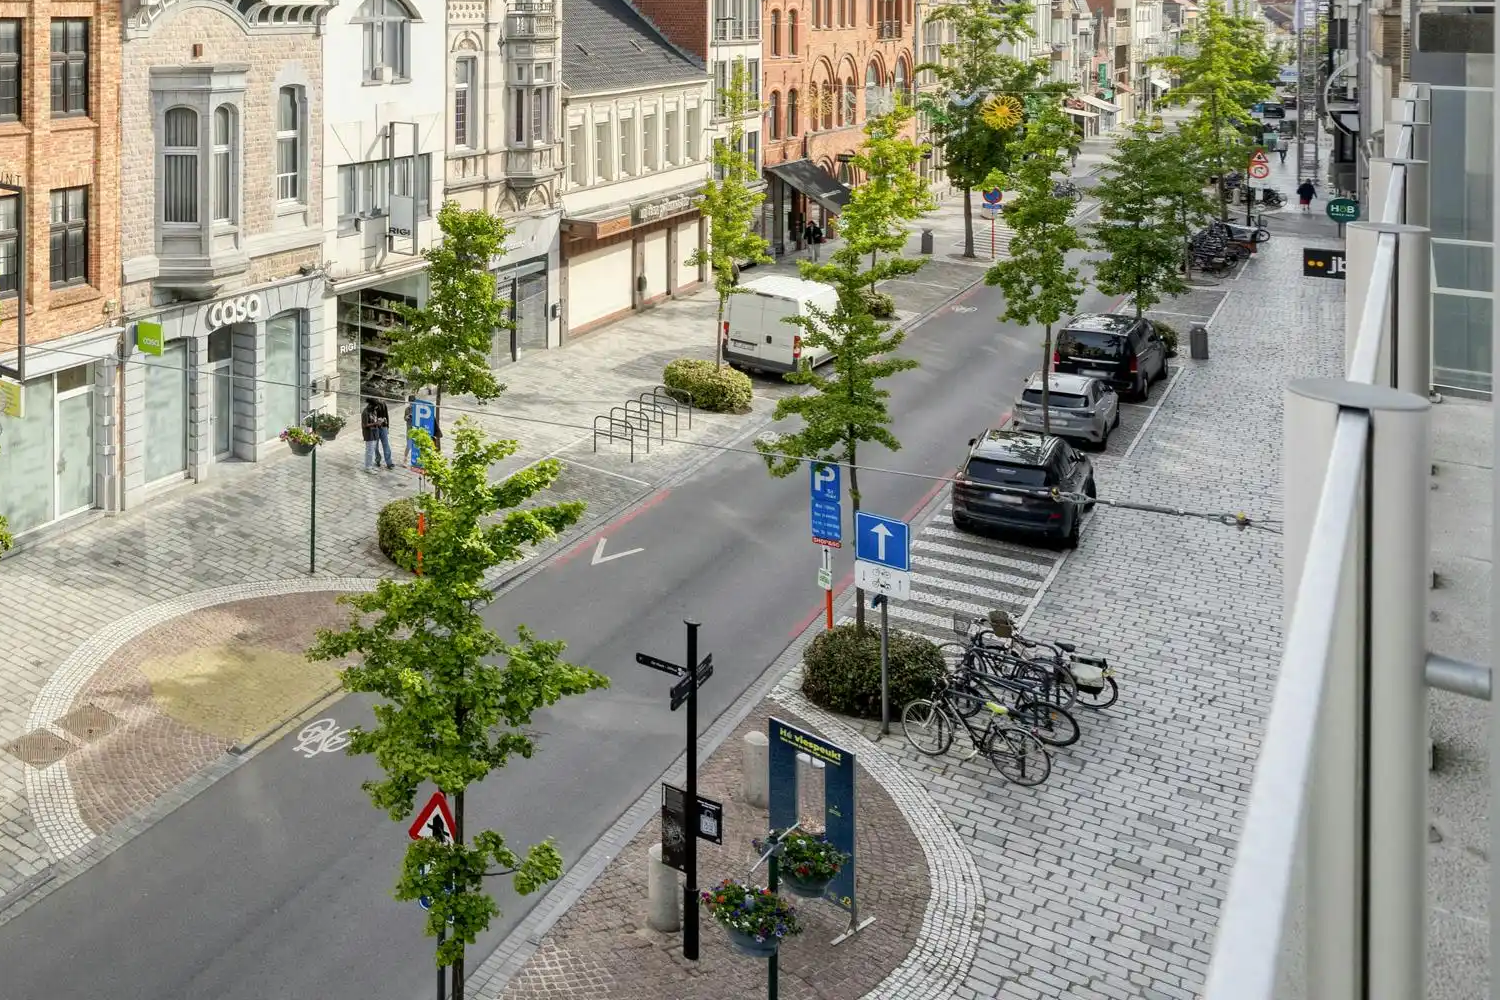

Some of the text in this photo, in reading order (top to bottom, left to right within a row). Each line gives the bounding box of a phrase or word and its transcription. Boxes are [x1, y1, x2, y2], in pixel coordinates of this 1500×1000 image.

[389, 226, 411, 236] RIGI
[1326, 256, 1346, 274] jb
[208, 293, 261, 328] casa
[340, 341, 357, 354] RIGI
[415, 404, 432, 427] P
[814, 466, 836, 491] P
